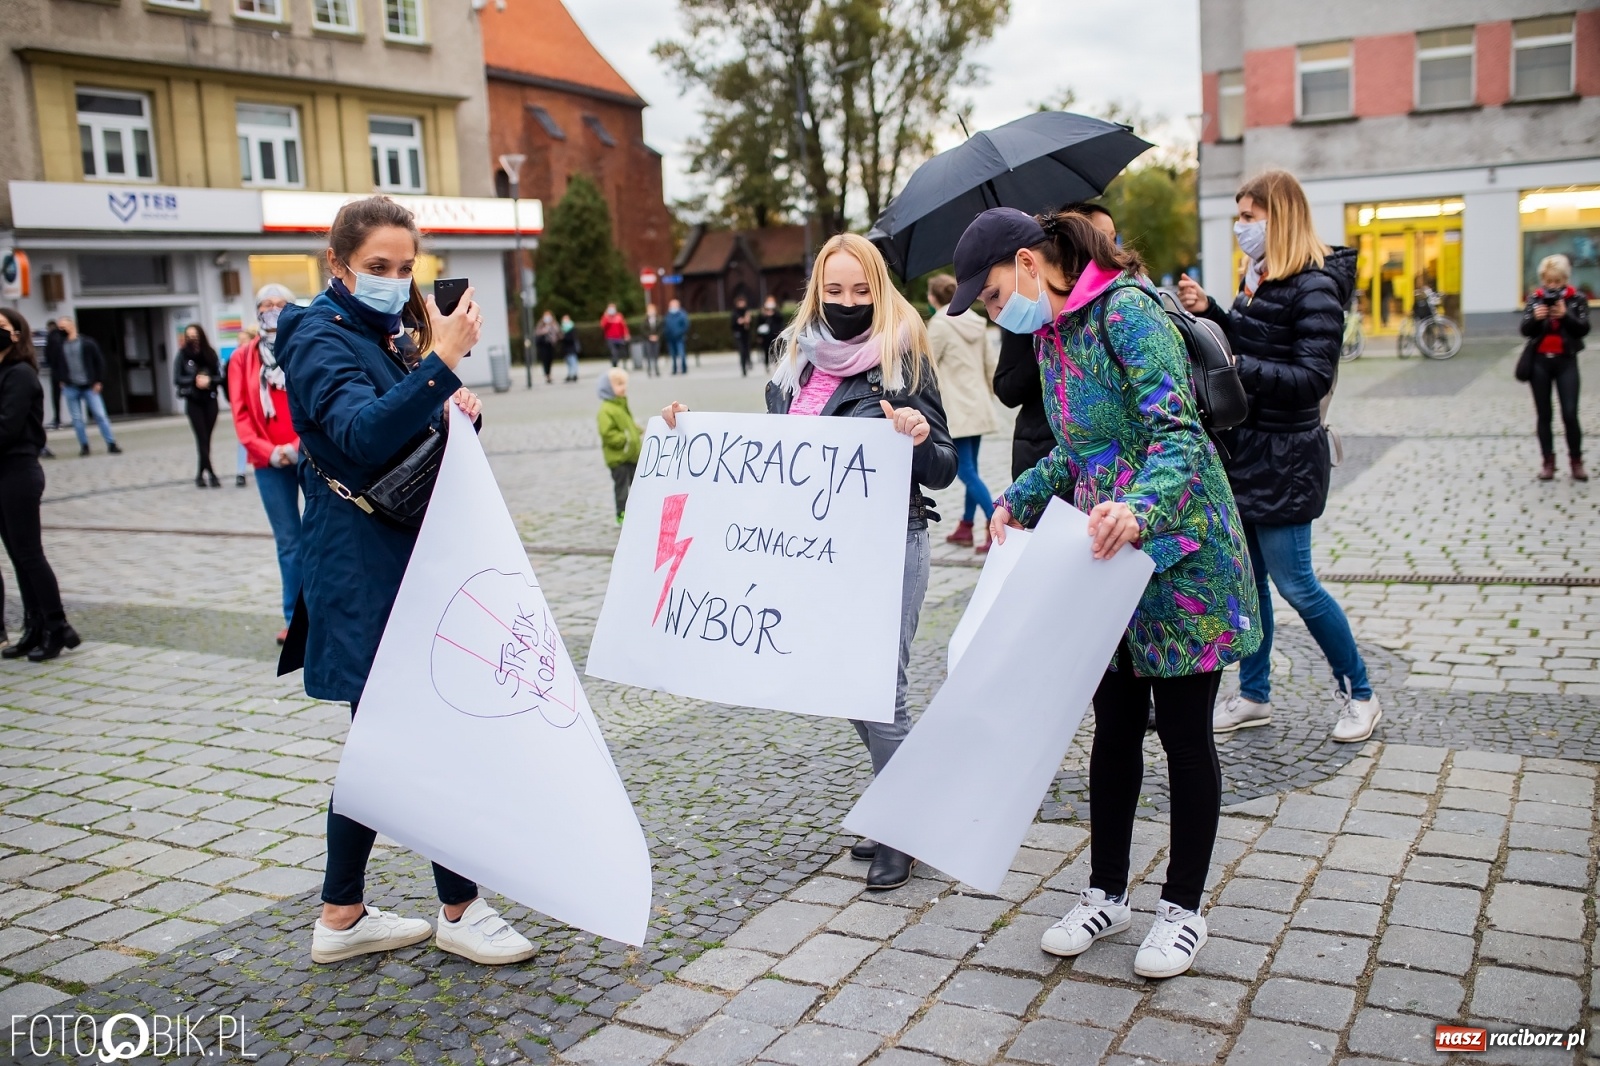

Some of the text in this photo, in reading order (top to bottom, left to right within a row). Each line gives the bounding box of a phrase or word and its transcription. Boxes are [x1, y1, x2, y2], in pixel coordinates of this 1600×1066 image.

[639, 431, 877, 521] DEMOKRACJA
[725, 522, 838, 564] OZNACZA
[495, 602, 539, 698] STRAJK
[664, 583, 793, 655] WYBÓR
